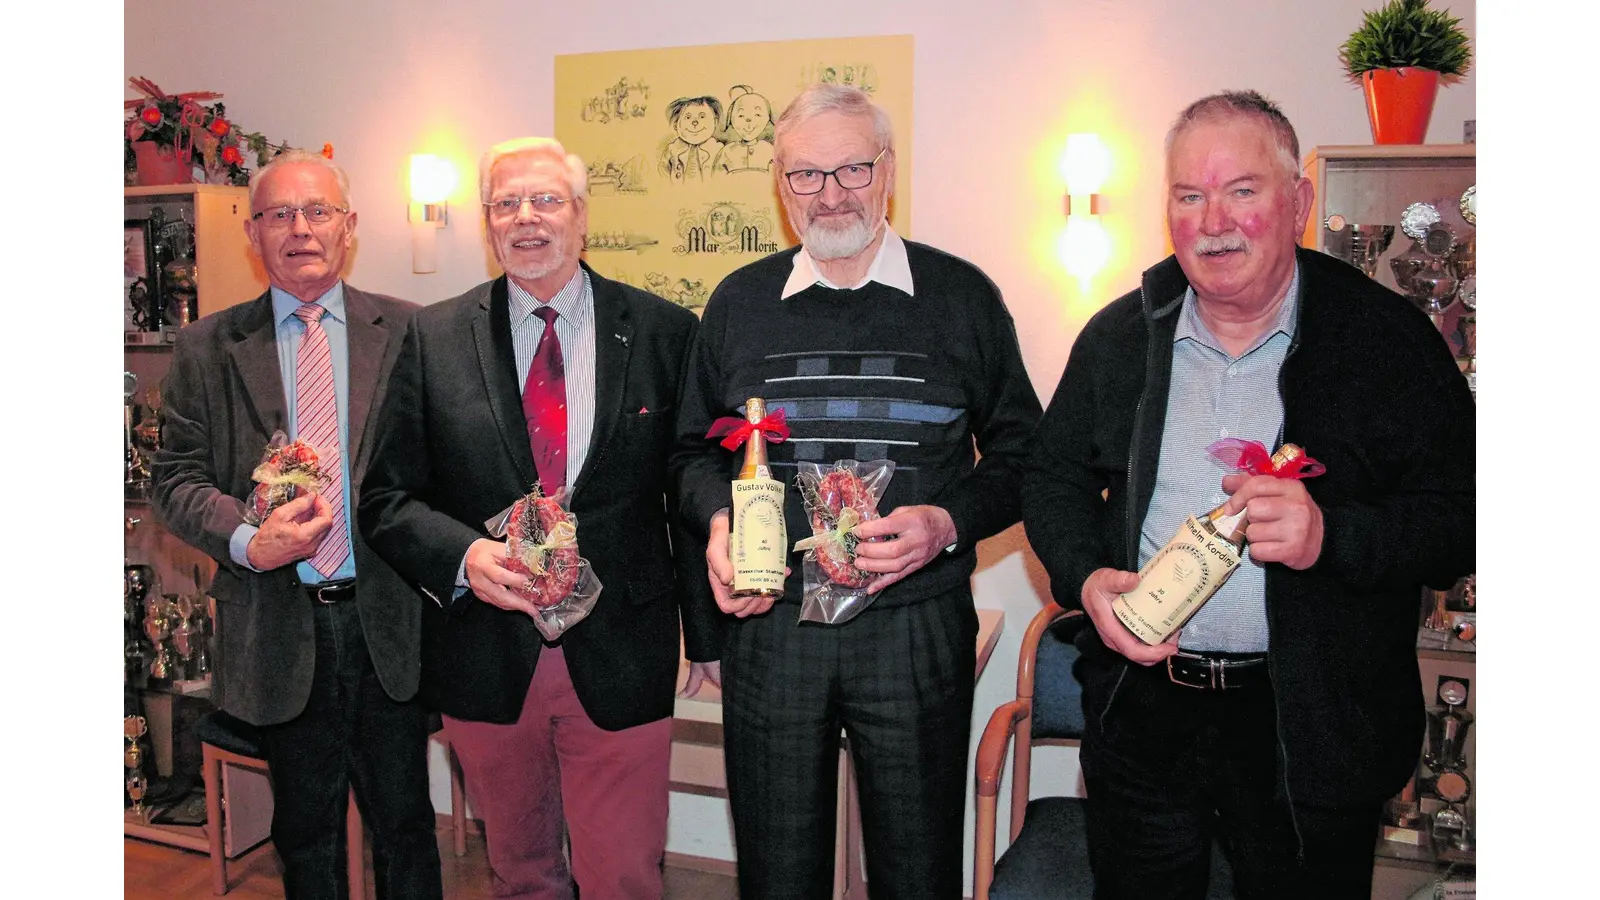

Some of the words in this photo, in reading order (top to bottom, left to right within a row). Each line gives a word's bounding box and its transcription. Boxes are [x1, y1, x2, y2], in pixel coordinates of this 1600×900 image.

[741, 226, 778, 253] Moritz
[736, 483, 764, 492] Gustav
[1205, 541, 1235, 568] Kording
[1148, 591, 1163, 604] Jahre
